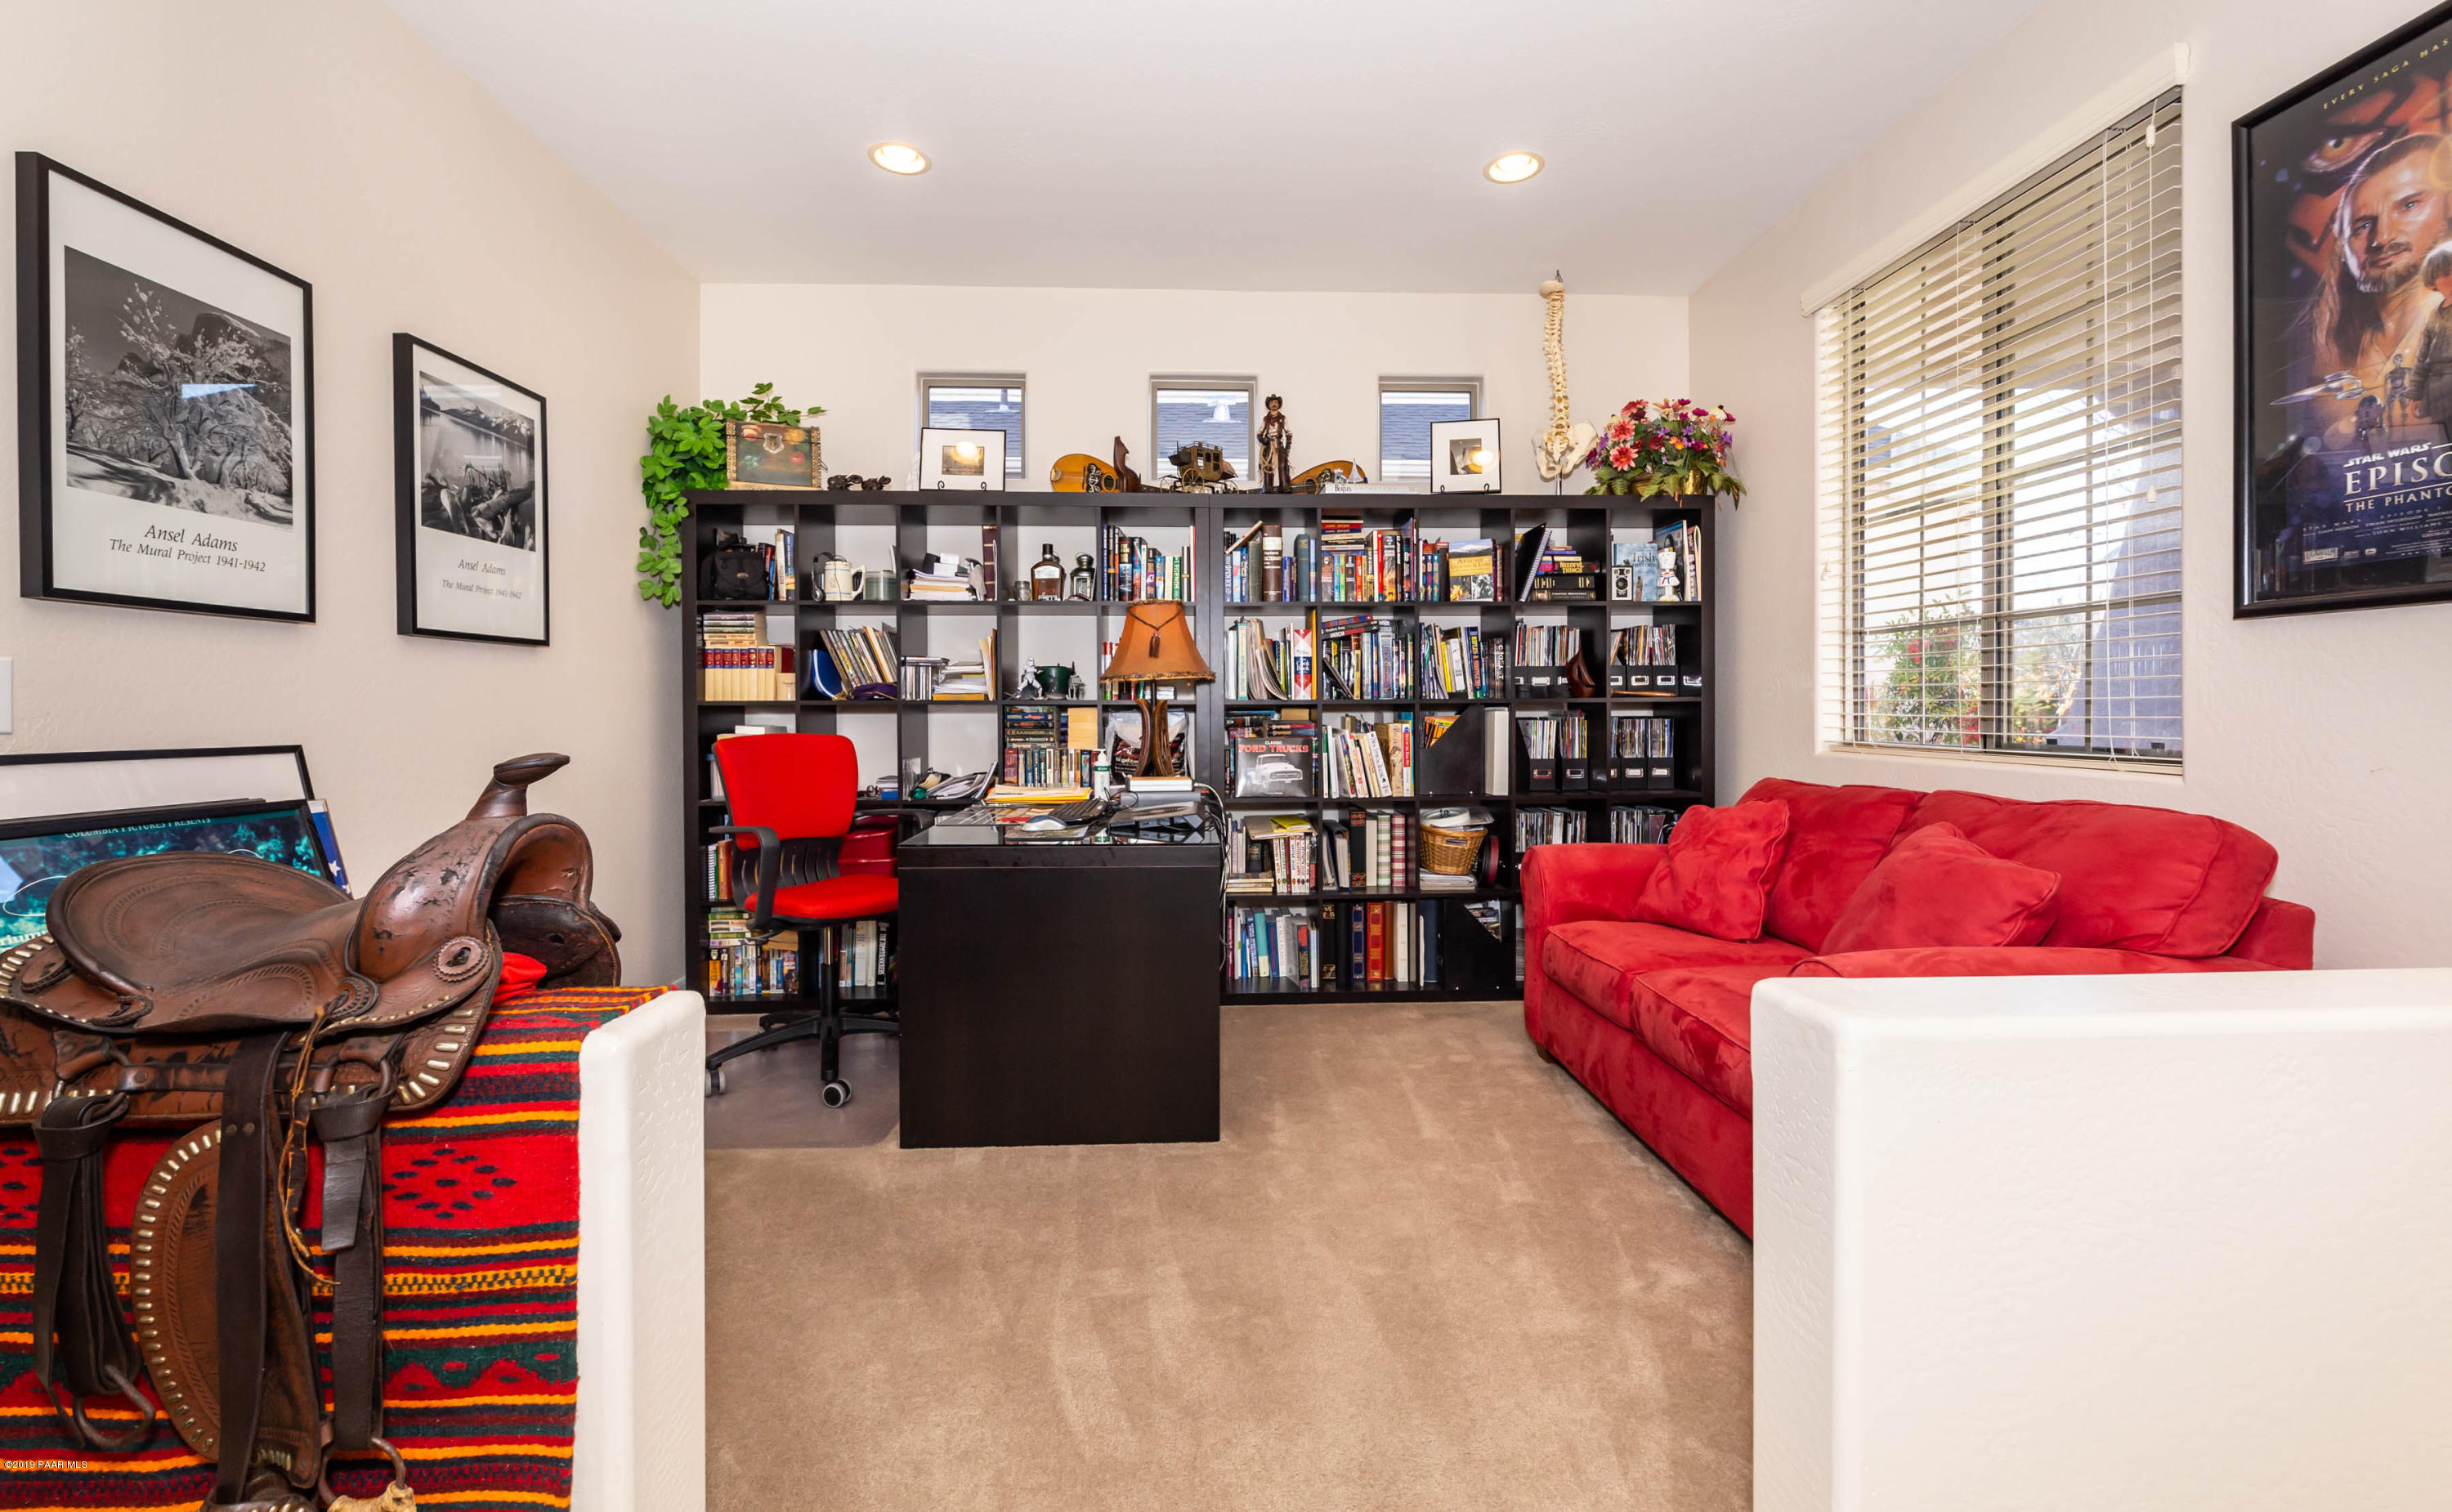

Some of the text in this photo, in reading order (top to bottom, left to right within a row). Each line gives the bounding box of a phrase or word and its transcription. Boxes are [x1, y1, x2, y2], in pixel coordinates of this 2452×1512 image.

[2323, 38, 2449, 110] EVERY SAGA HAS
[2343, 442, 2432, 467] STAR WARS
[2346, 499, 2375, 512] THE
[144, 525, 238, 552] Ansel Adams
[110, 539, 266, 572] The Mural Project 1941-1942
[1632, 552, 1655, 562] Irish
[458, 558, 506, 575] Ansel Adams
[442, 579, 454, 588] The
[455, 581, 474, 592] Mural
[476, 585, 493, 595] Project
[1238, 744, 1309, 753] FORD TRUCKS
